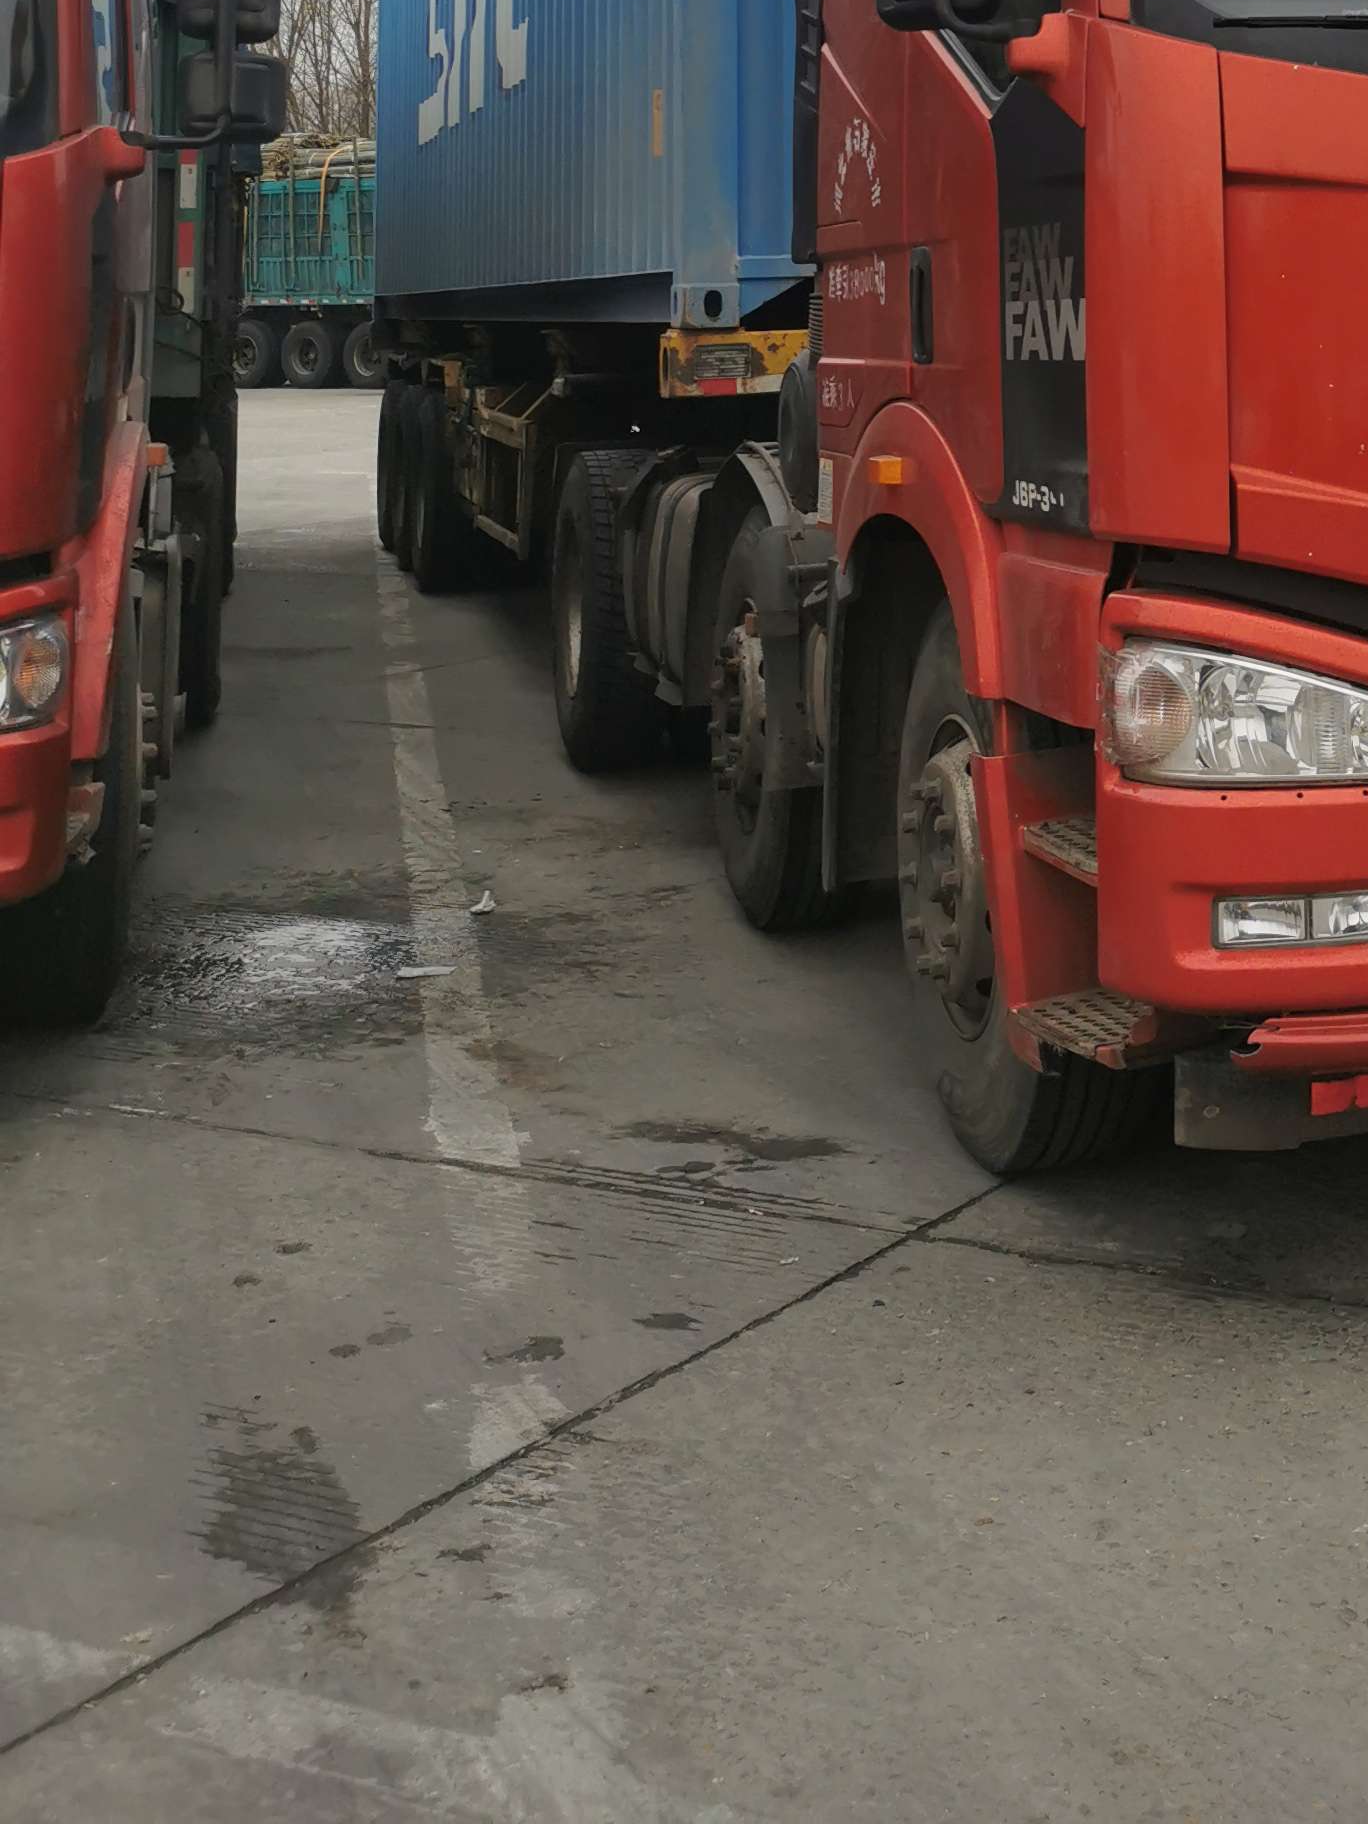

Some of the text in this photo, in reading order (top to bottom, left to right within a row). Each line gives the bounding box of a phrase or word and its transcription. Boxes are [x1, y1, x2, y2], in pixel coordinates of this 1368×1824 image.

[1003, 222, 1062, 263] FAW
[1004, 256, 1075, 303] FAW
[1005, 297, 1087, 361] FAW
